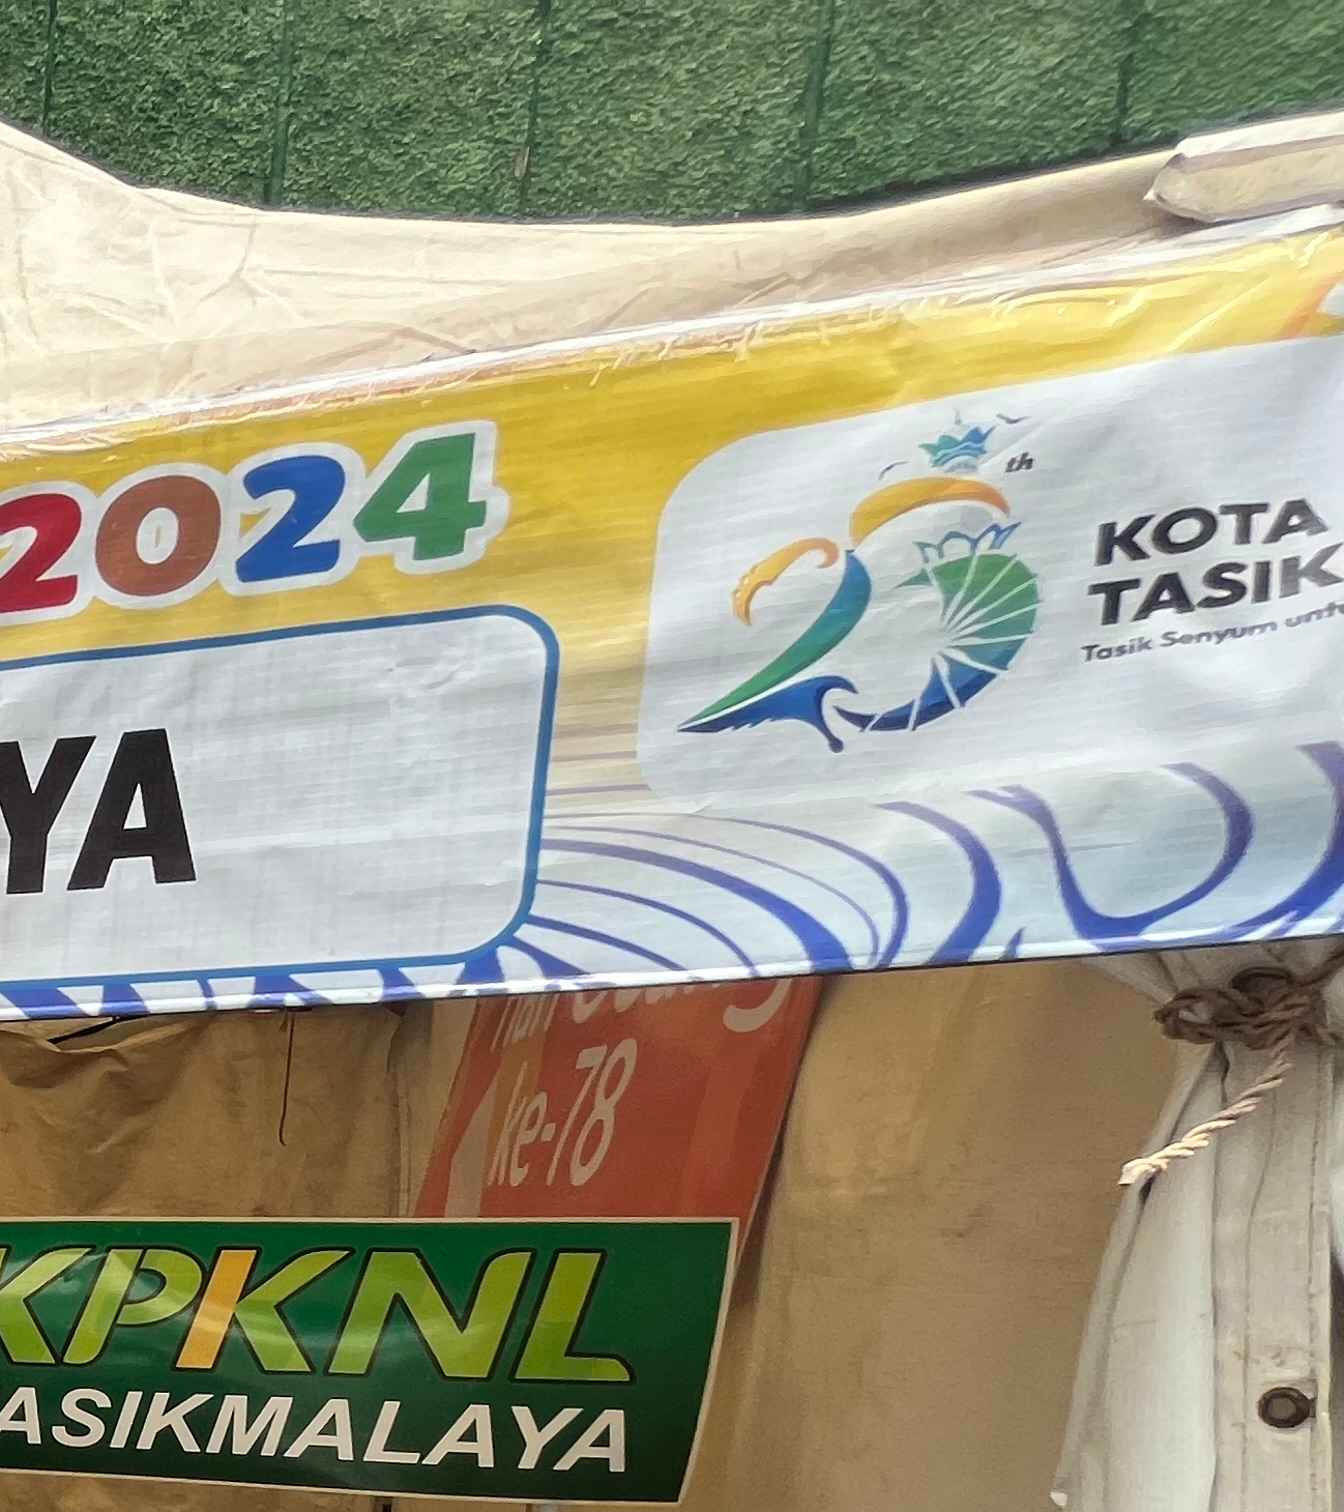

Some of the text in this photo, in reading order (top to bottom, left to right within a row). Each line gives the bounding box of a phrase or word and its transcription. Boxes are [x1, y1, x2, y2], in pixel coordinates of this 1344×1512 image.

[1095, 498, 1328, 567] KOTA
[1081, 635, 1152, 662] Tasik
[1160, 621, 1278, 648] Senyum
